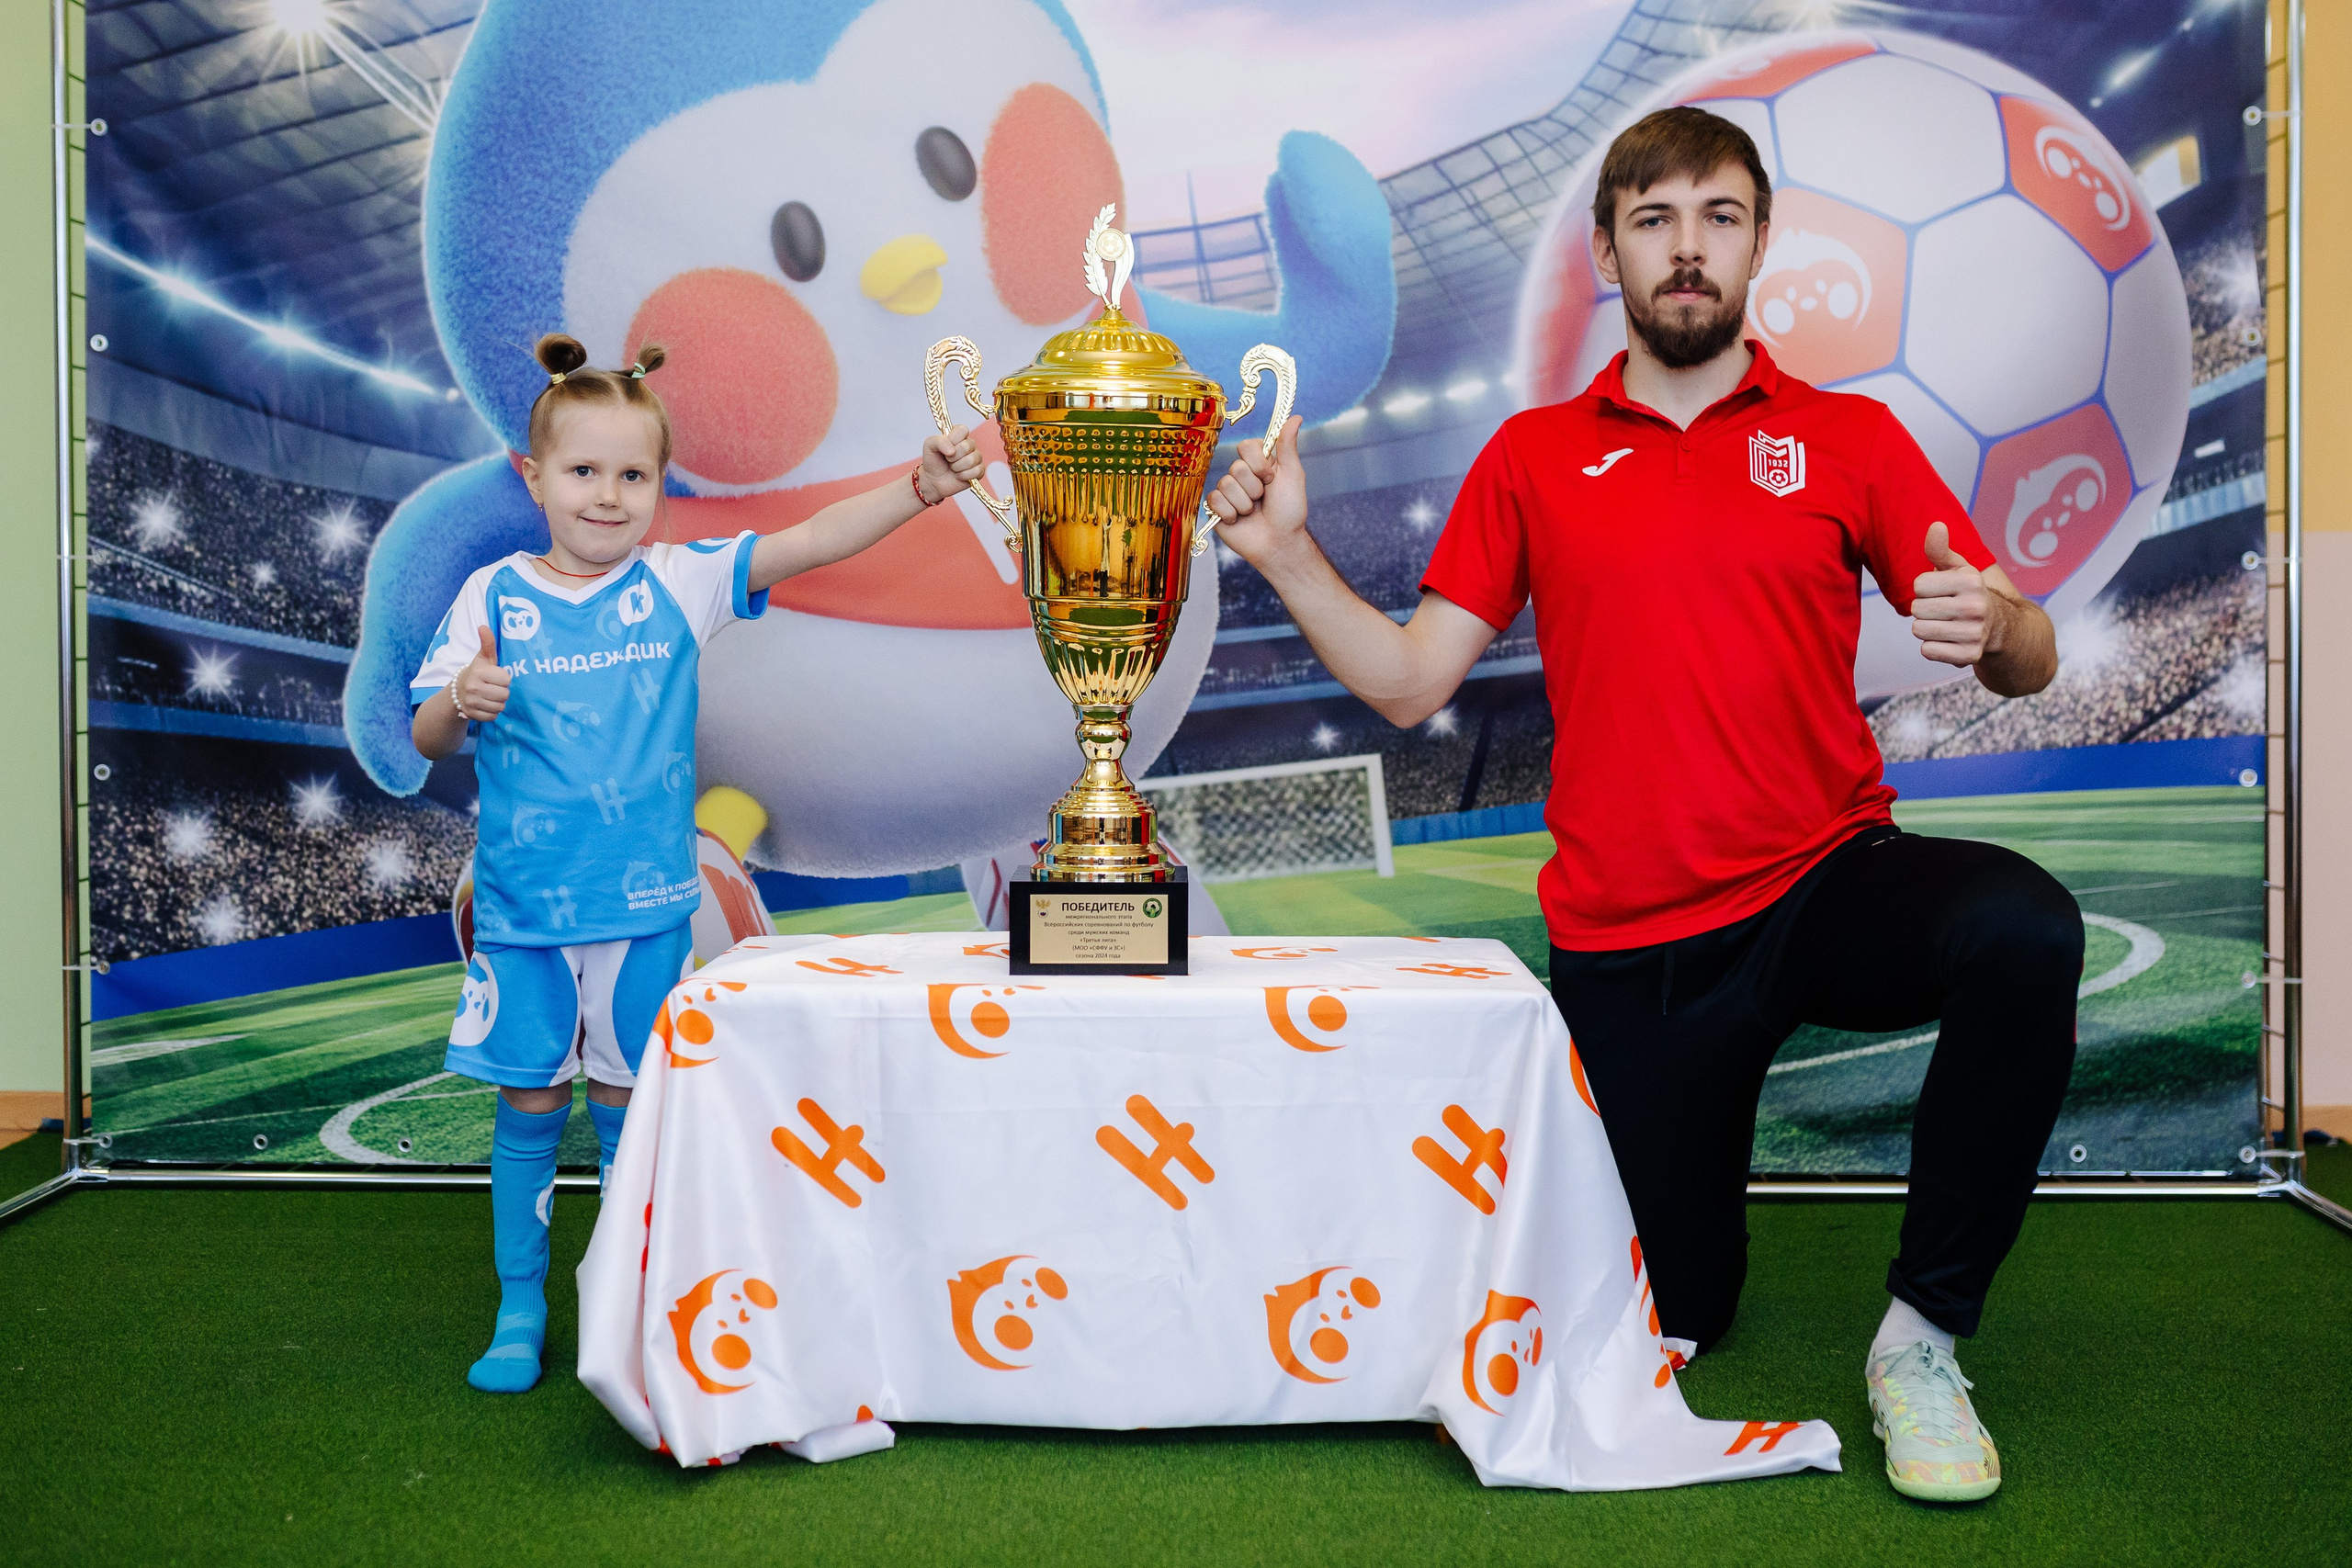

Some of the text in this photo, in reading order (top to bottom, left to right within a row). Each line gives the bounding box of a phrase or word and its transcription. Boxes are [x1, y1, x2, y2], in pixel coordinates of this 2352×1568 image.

[1769, 459, 1788, 468] 1932
[628, 886, 668, 900] ВПЕРЁД
[628, 897, 668, 910] ВМЕСТЕ
[670, 893, 684, 903] МЫ
[1061, 902, 1135, 913] ПОБЕДИТЕЛЬ
